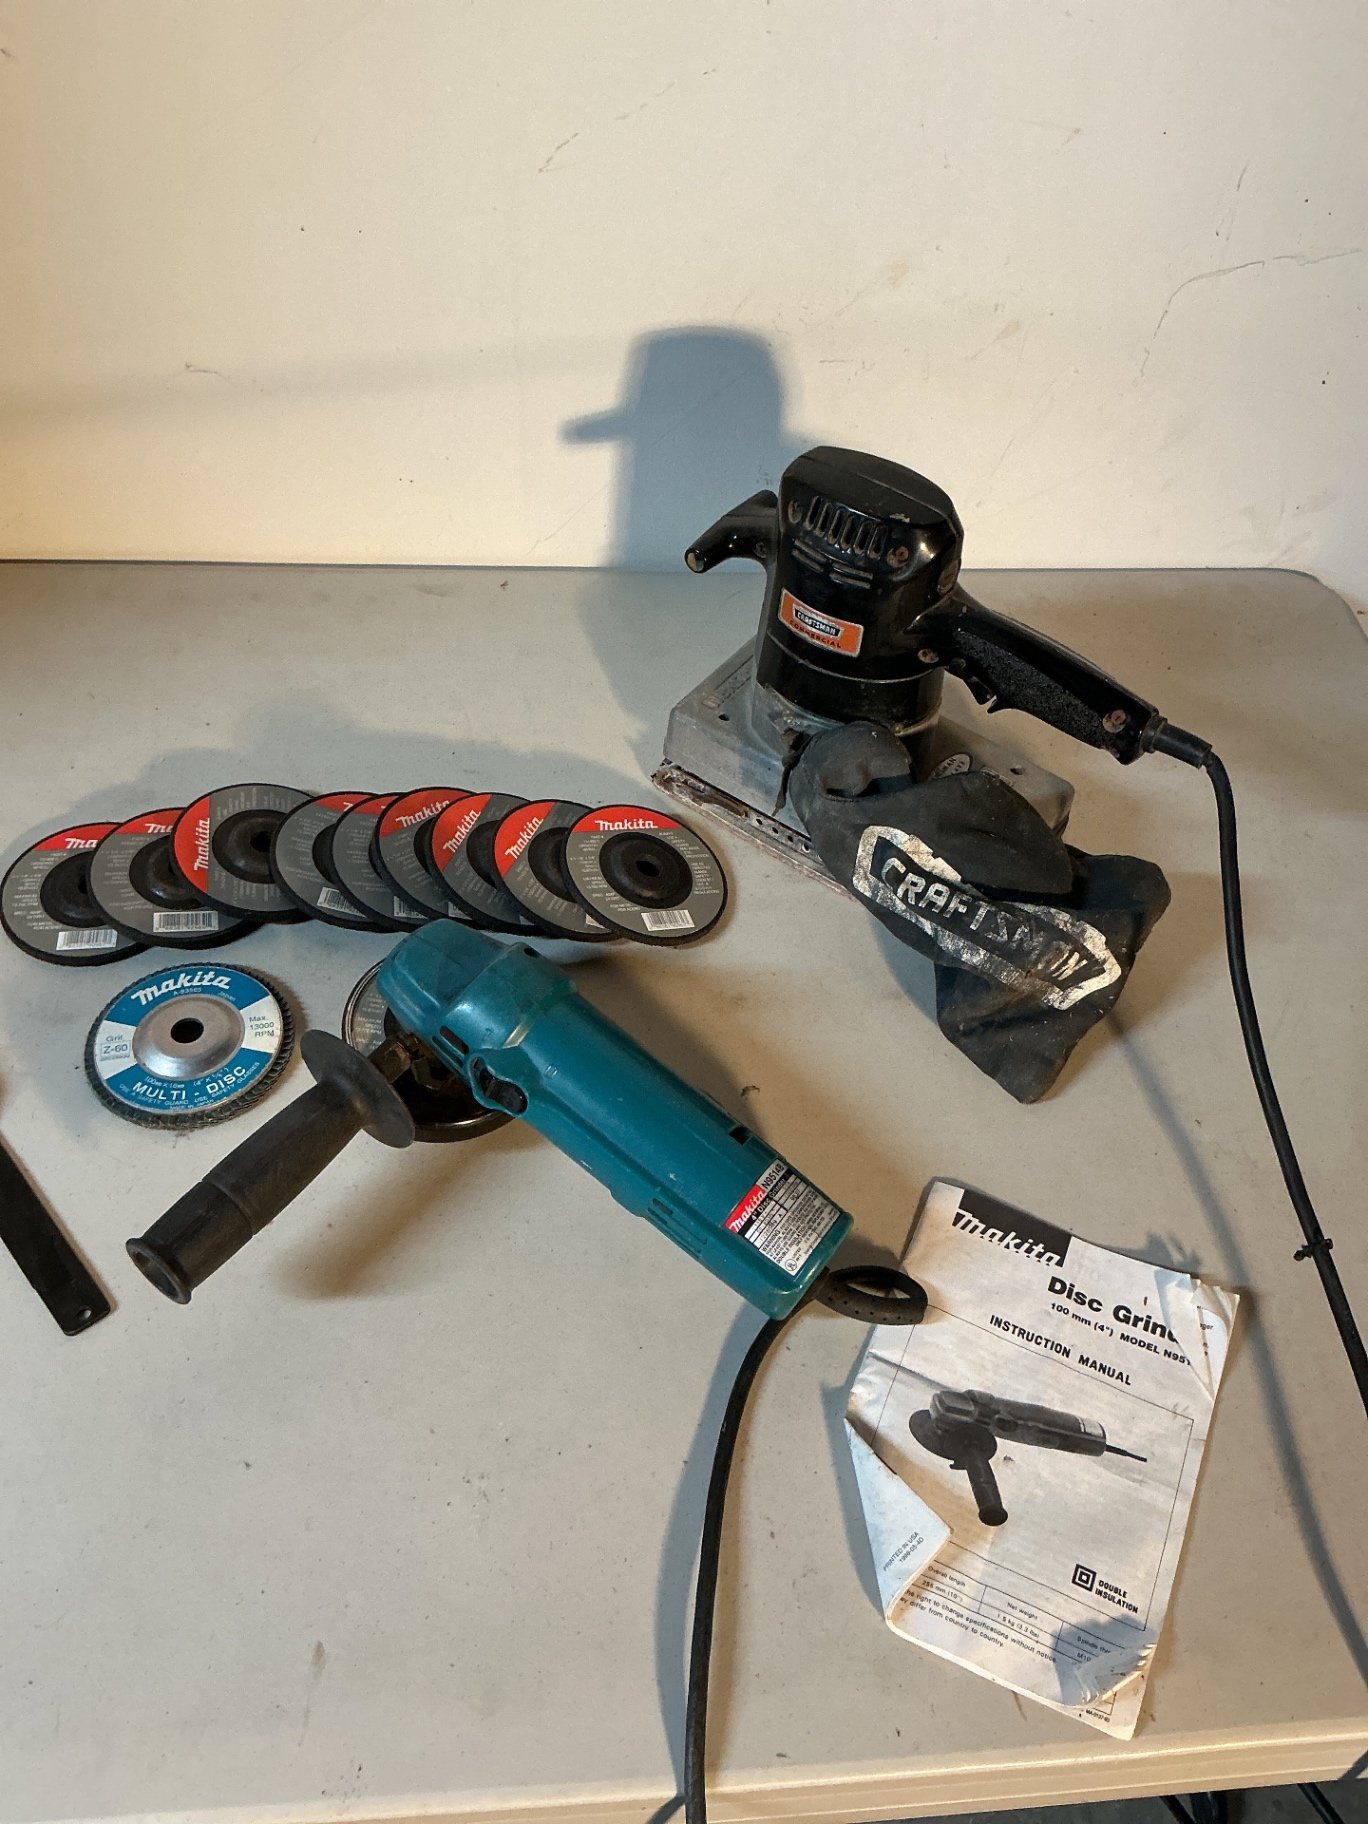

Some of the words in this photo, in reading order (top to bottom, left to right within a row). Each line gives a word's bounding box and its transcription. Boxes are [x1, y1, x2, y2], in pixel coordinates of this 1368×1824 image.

[789, 620, 842, 648] COMMERCIAL
[797, 611, 836, 635] CRAFTSMAN
[595, 817, 659, 831] makita
[881, 857, 1088, 981] CRAFTSN
[131, 971, 231, 1006] makita
[249, 1022, 275, 1031] 13000
[254, 1030, 275, 1038] RPM
[103, 1043, 129, 1055] Z-60
[132, 1081, 187, 1100] MULTI
[206, 1066, 246, 1094] DISC
[758, 1197, 770, 1213] Disc
[768, 1178, 785, 1199] Grinder
[728, 1189, 767, 1233] makita
[953, 1208, 1064, 1266] makita
[1048, 1275, 1103, 1313] Disc
[1051, 1303, 1070, 1316] 100
[1071, 1312, 1092, 1327] mm
[1119, 1332, 1160, 1355] MODEL
[989, 1314, 1071, 1358] INSTRUCTION
[1078, 1354, 1132, 1386] MANUAL
[908, 1531, 919, 1546] USA
[928, 1565, 948, 1579] Overall
[948, 1574, 967, 1588] length
[1098, 1579, 1128, 1599] DOUBLE
[909, 1600, 927, 1612] differ
[928, 1606, 945, 1620] from
[944, 1616, 969, 1631] country
[1018, 1608, 1038, 1620] weight
[1095, 1588, 1139, 1614] INSULATION
[915, 1592, 932, 1604] right
[941, 1603, 964, 1619] change
[965, 1616, 1009, 1640] specifications
[1011, 1637, 1035, 1653] without
